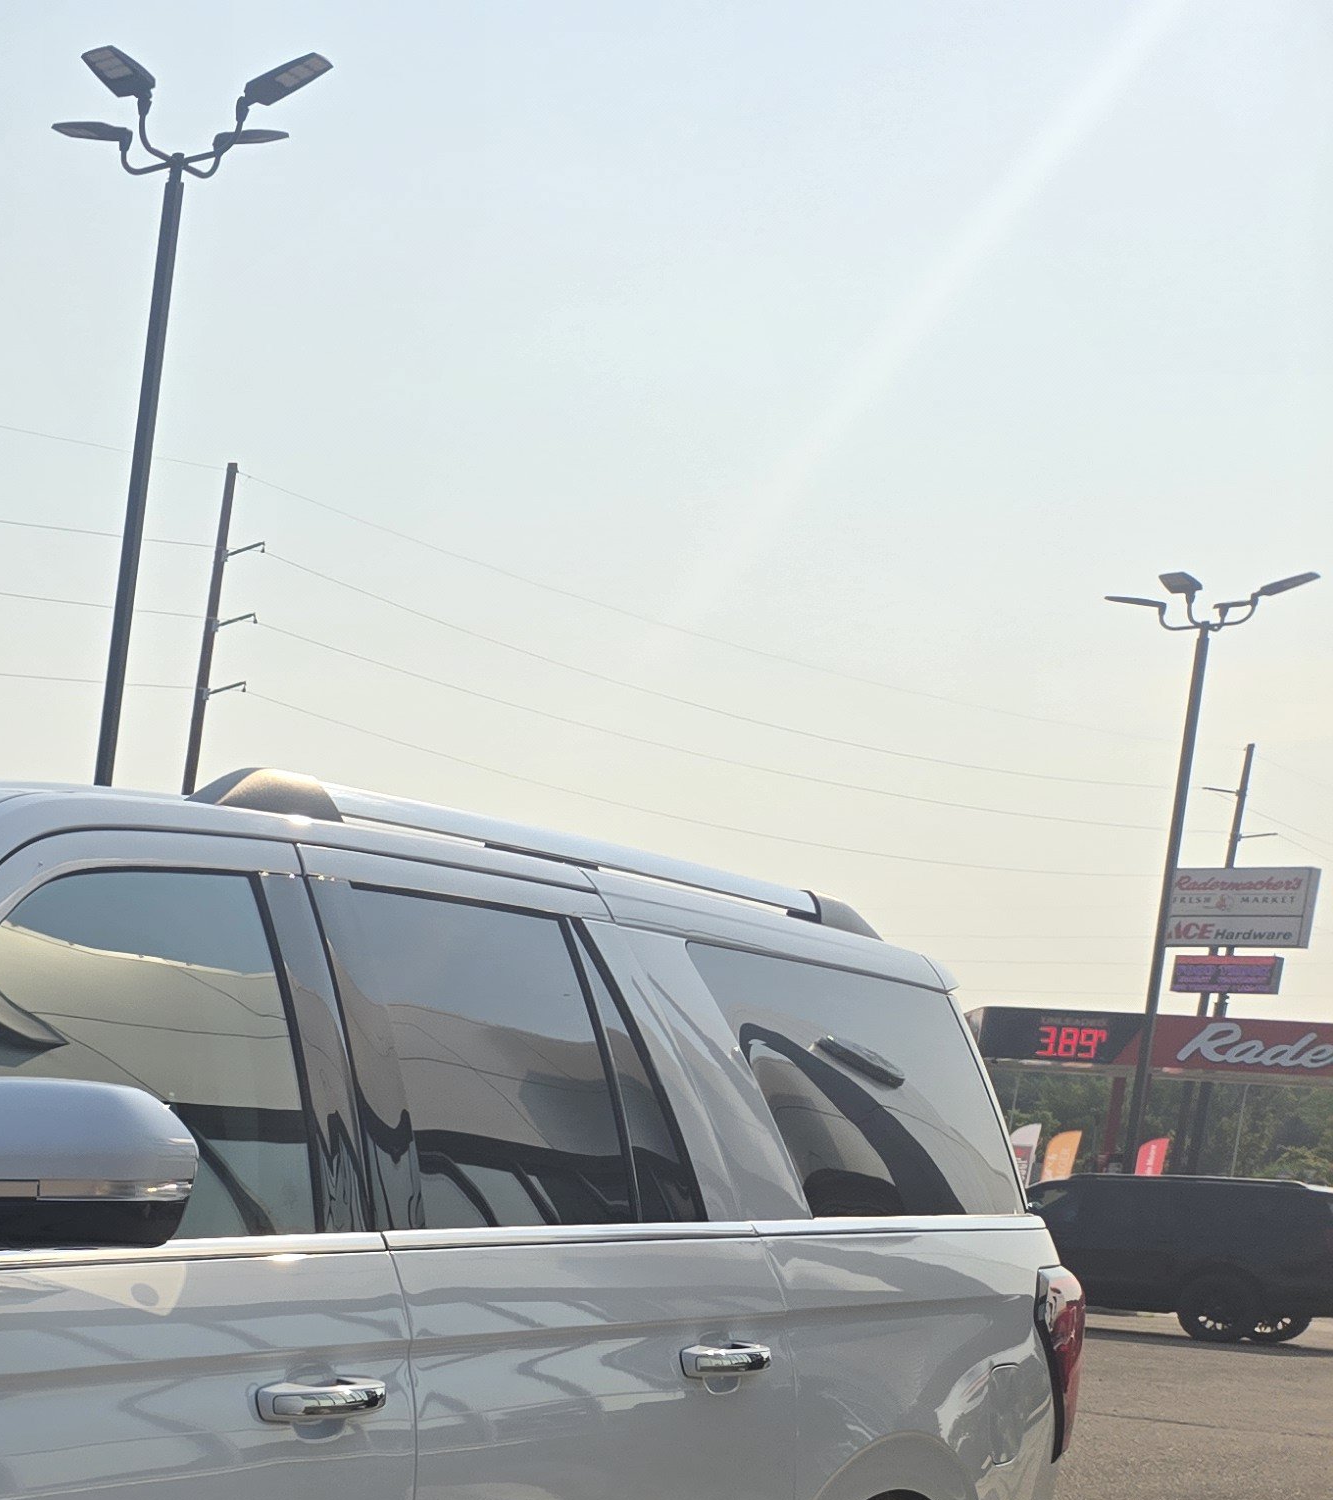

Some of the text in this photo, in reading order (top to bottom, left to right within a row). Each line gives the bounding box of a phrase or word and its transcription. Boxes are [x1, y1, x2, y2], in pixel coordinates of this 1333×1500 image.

[1240, 896, 1295, 904] MARKET
[1167, 920, 1293, 941] ACE Hardware
